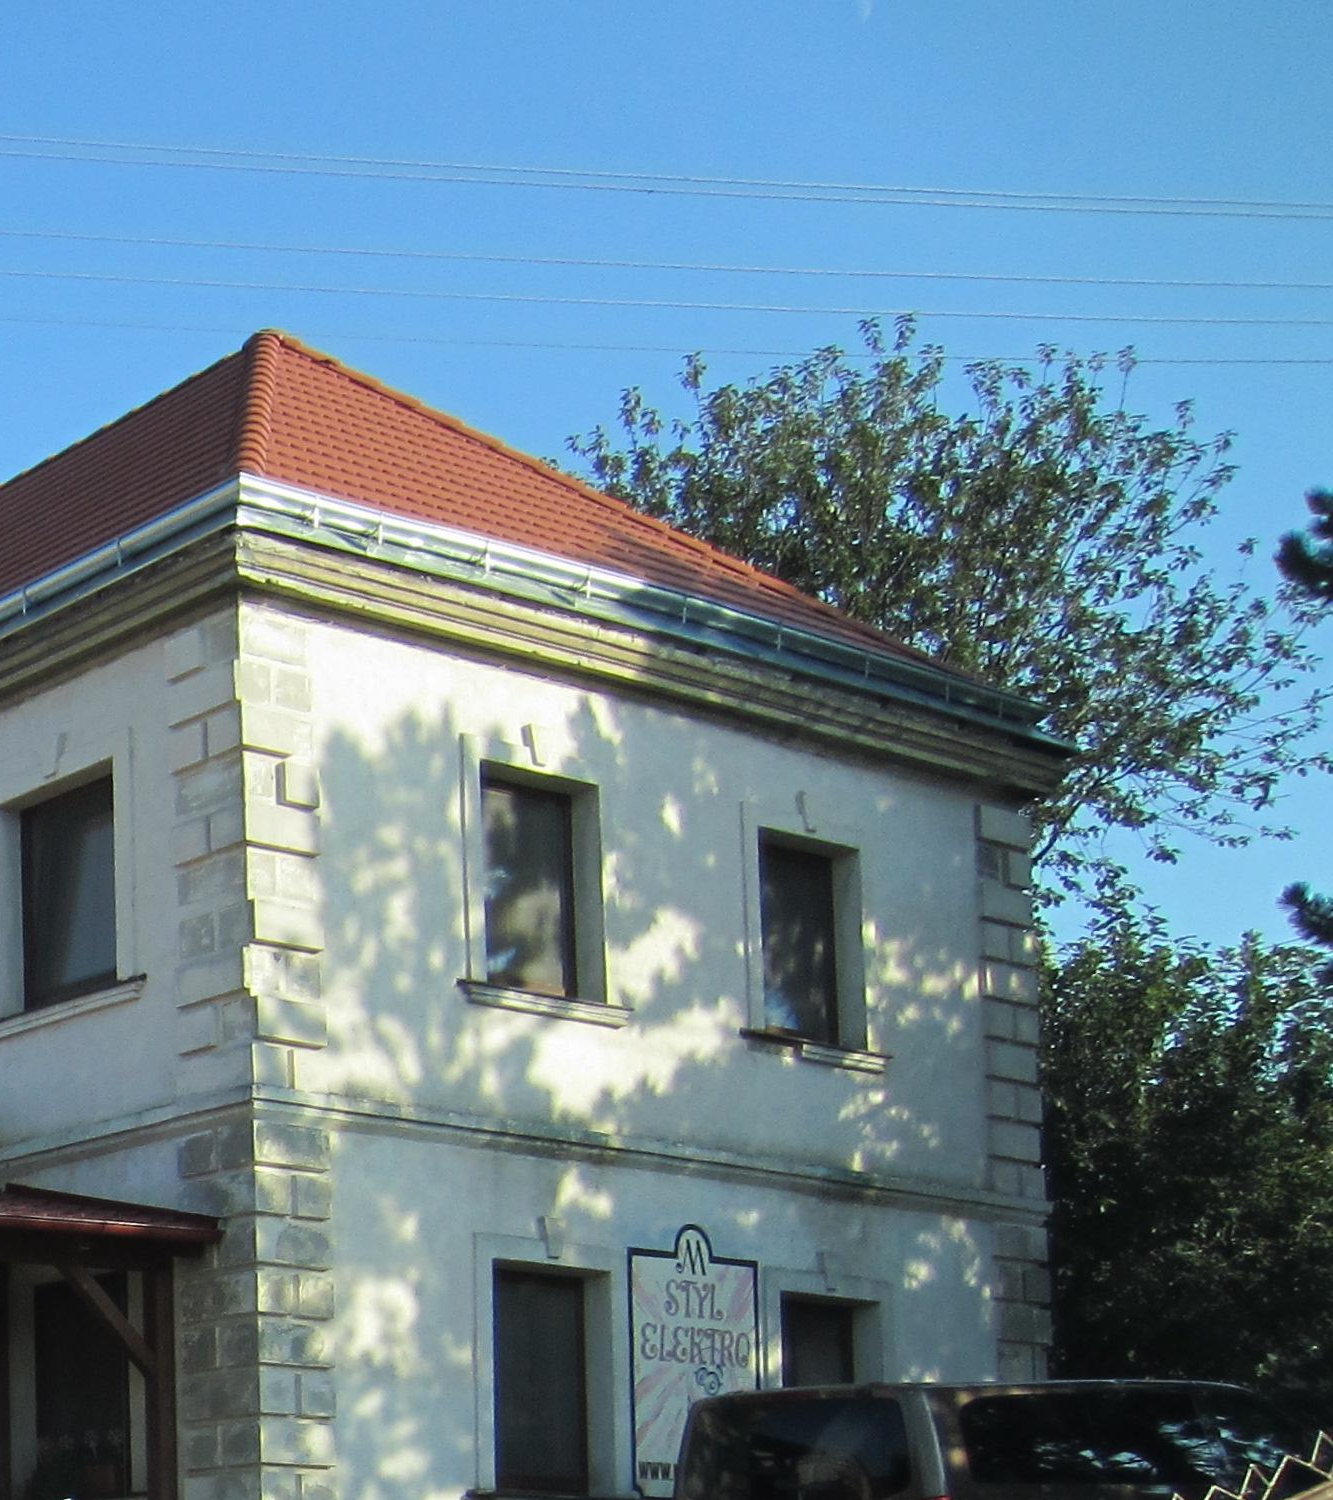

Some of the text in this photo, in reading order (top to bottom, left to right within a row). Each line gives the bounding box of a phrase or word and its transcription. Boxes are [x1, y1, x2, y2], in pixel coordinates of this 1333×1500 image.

[675, 1238, 708, 1276] M
[664, 1279, 725, 1321] STYL
[640, 1322, 751, 1369] ELEKTRO
